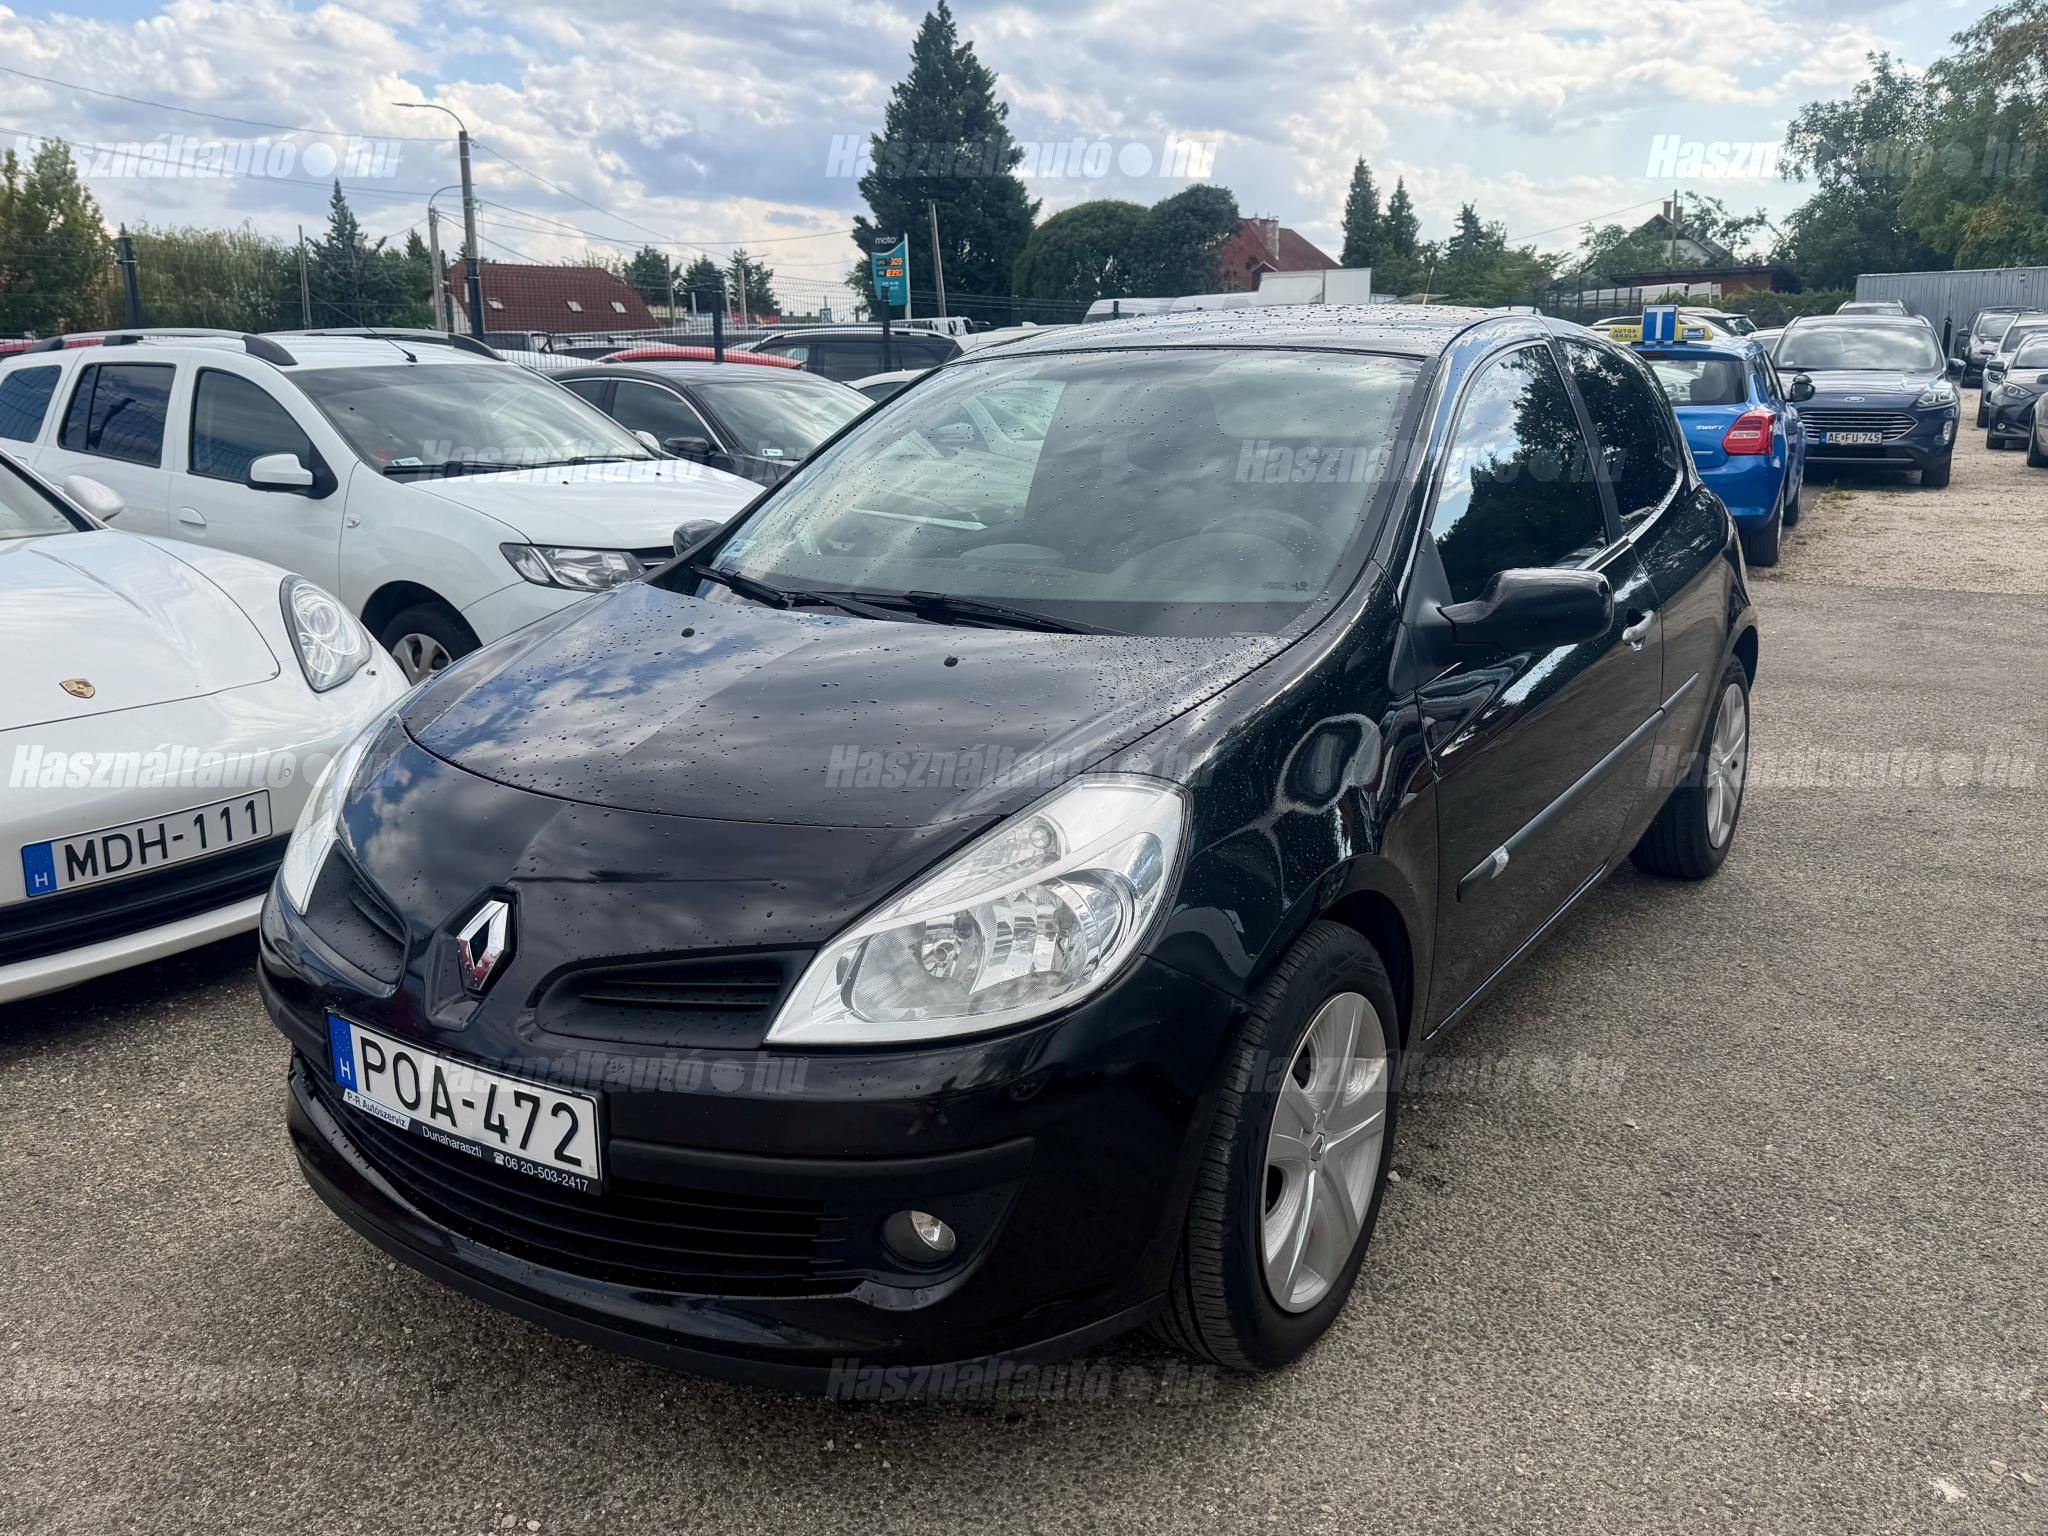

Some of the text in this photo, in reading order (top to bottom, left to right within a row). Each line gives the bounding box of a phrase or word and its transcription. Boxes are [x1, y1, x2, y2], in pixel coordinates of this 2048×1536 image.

[1646, 307, 1674, 339] T
[64, 799, 258, 882] MDH-111
[34, 872, 49, 887] H
[340, 1058, 351, 1080] H
[360, 1036, 582, 1168] POA-472
[362, 1100, 407, 1128] Autószerviz
[422, 1126, 482, 1158] Dunaharaszti
[505, 1155, 589, 1192] 06 20-503-2417
